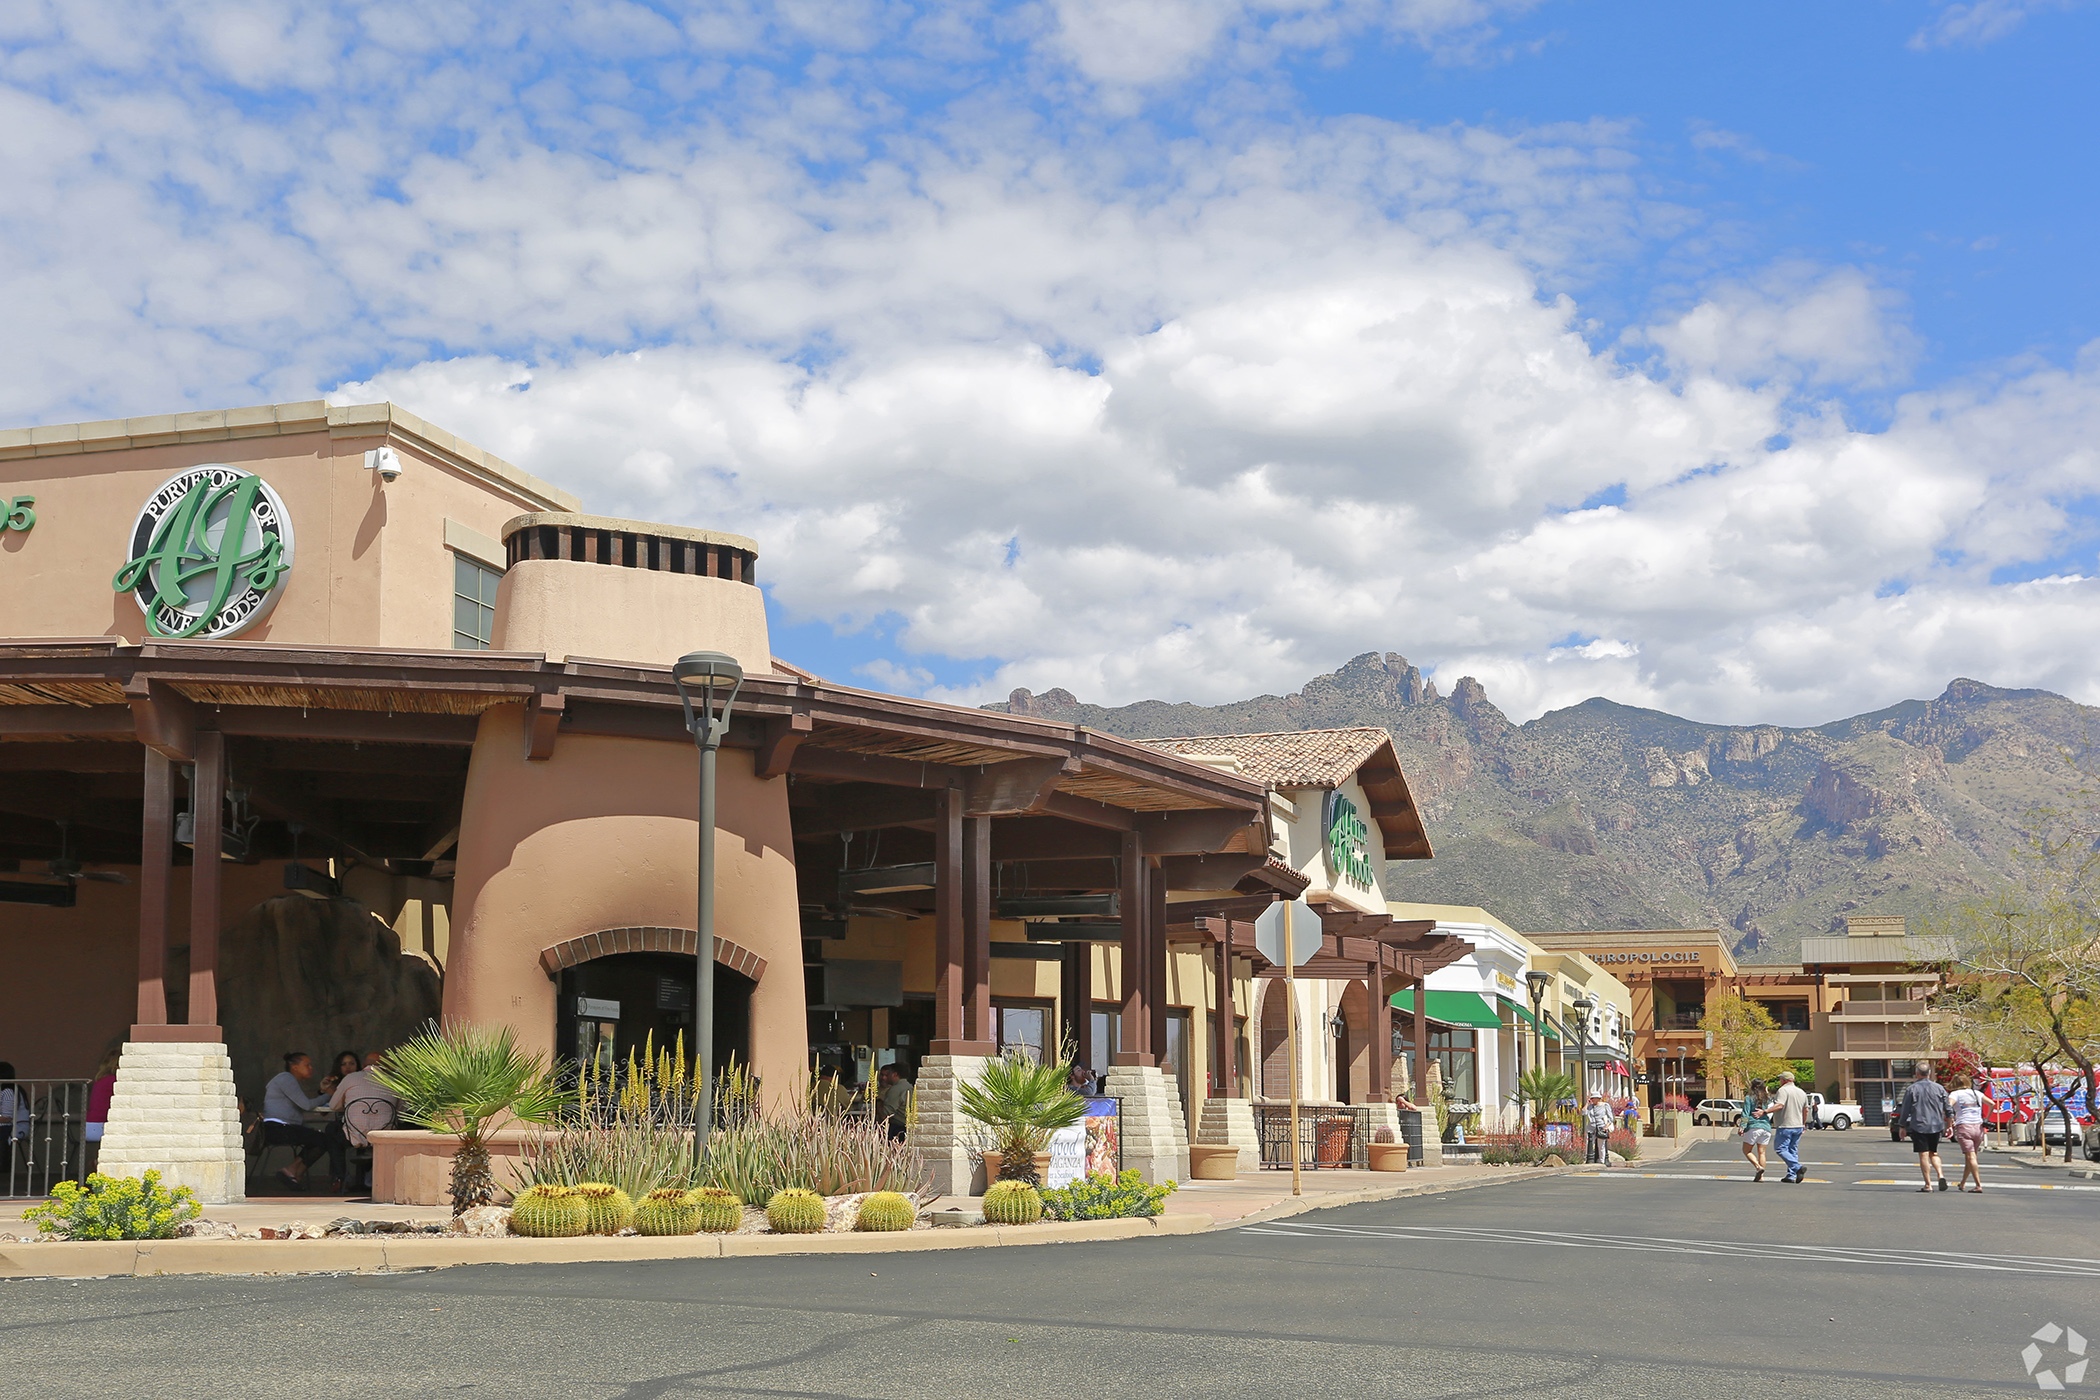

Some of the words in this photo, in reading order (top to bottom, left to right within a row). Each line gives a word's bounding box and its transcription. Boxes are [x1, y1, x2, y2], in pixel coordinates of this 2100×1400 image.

[146, 470, 240, 521] PURVEYOR
[255, 501, 277, 528] OF
[148, 602, 193, 633] INE
[201, 591, 261, 634] OODS
